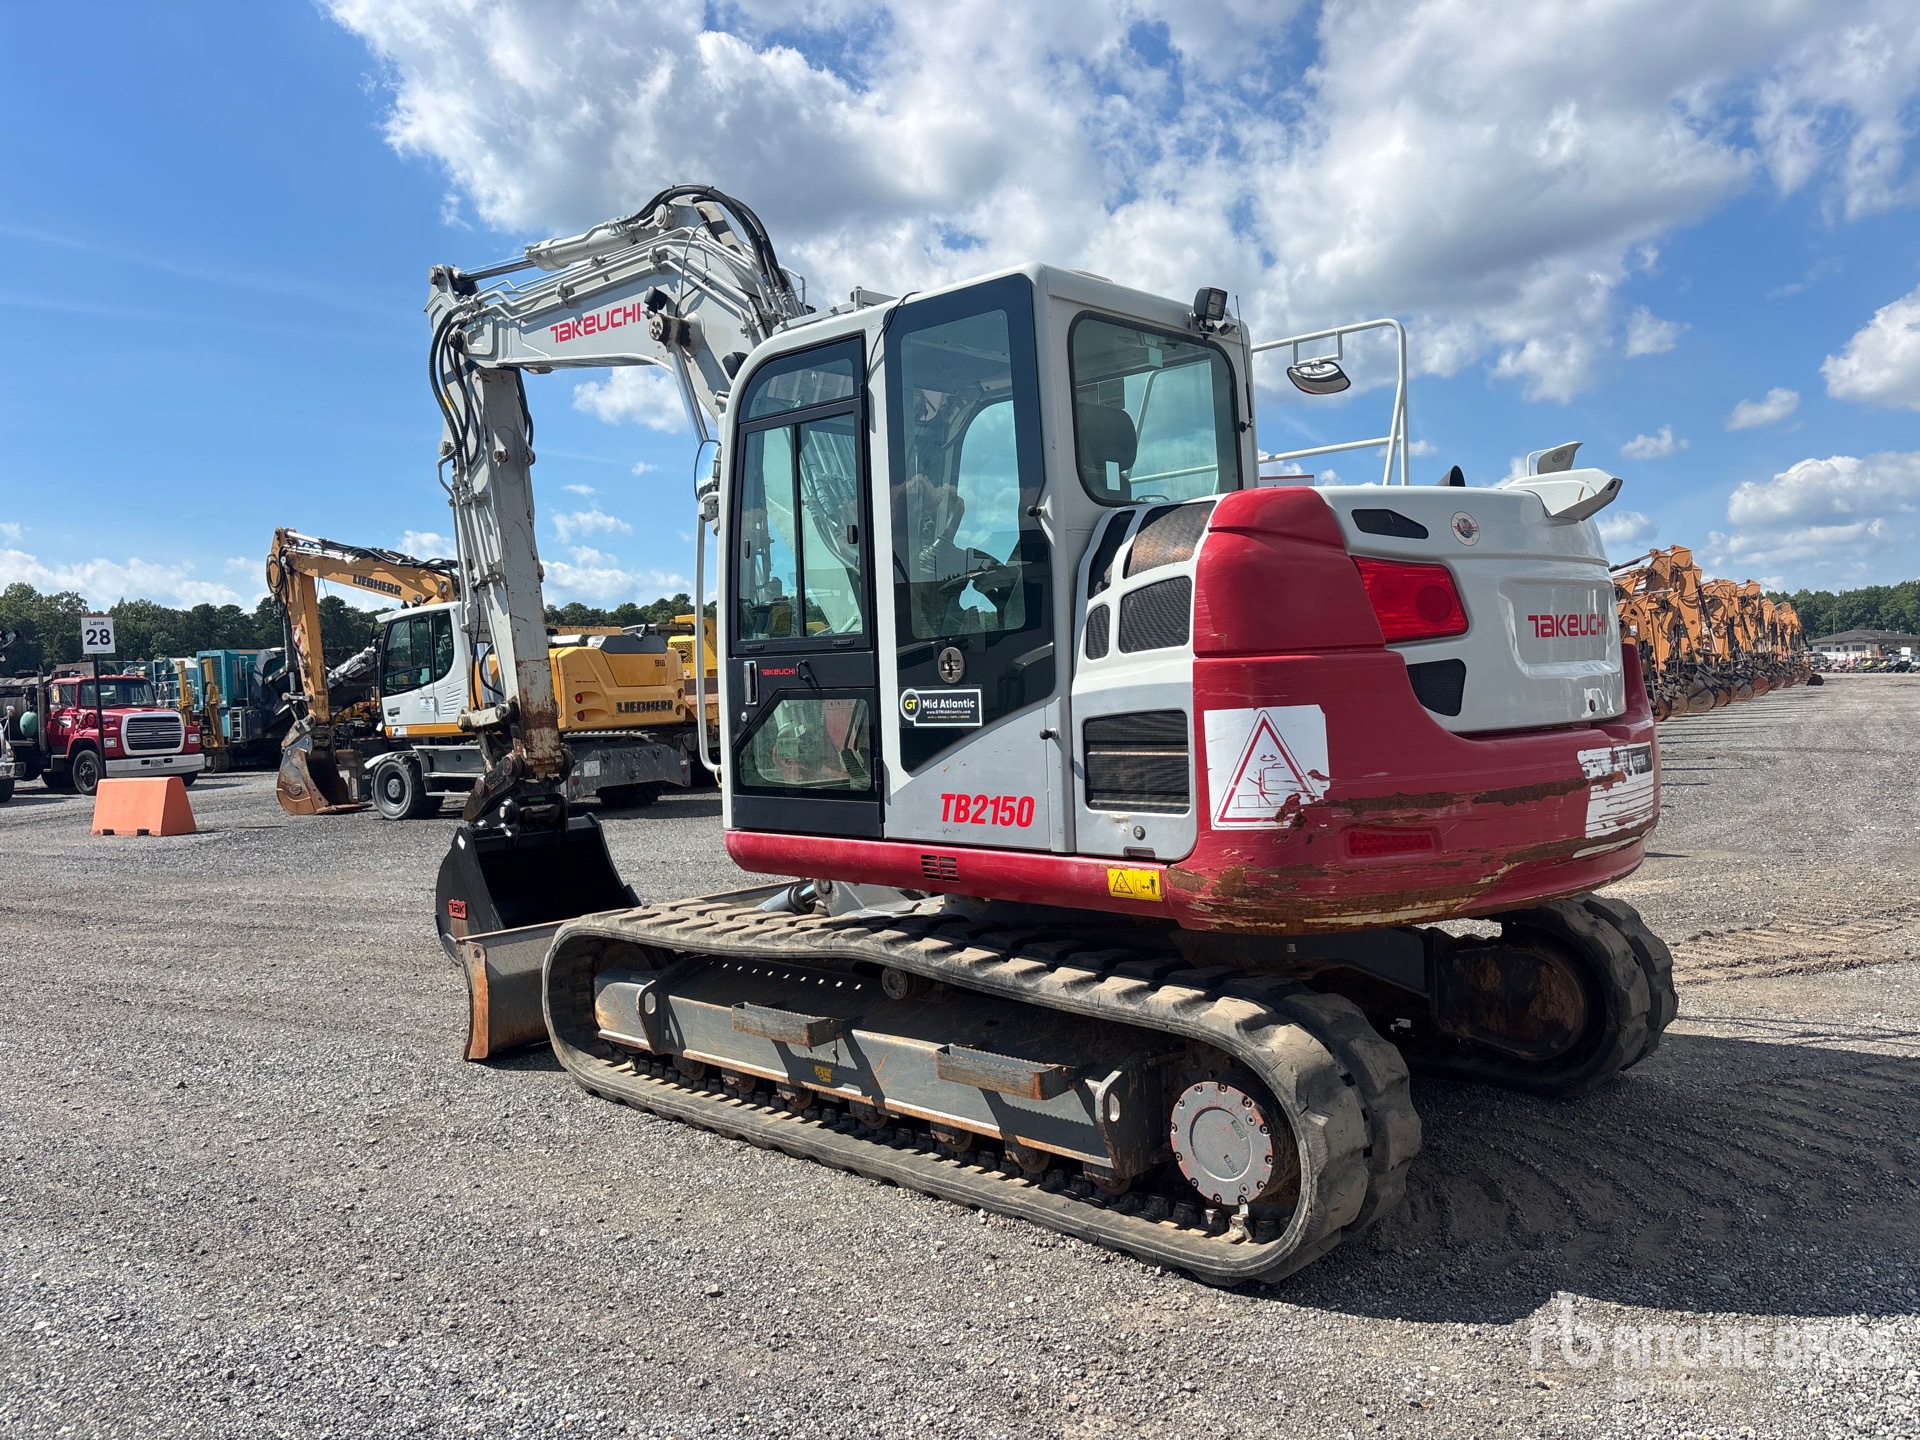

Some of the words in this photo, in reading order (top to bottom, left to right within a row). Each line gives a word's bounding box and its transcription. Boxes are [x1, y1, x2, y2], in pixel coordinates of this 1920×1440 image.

[550, 303, 641, 343] TAKEUCHI
[352, 573, 402, 596] LIEBHERR
[1527, 613, 1606, 638] TAKEUCHI
[85, 628, 111, 646] 28
[616, 699, 674, 713] LIEBHERR
[904, 699, 917, 710] GT
[922, 699, 938, 709] Mid
[940, 698, 975, 709] Atlantic
[940, 793, 1035, 828] TB2150
